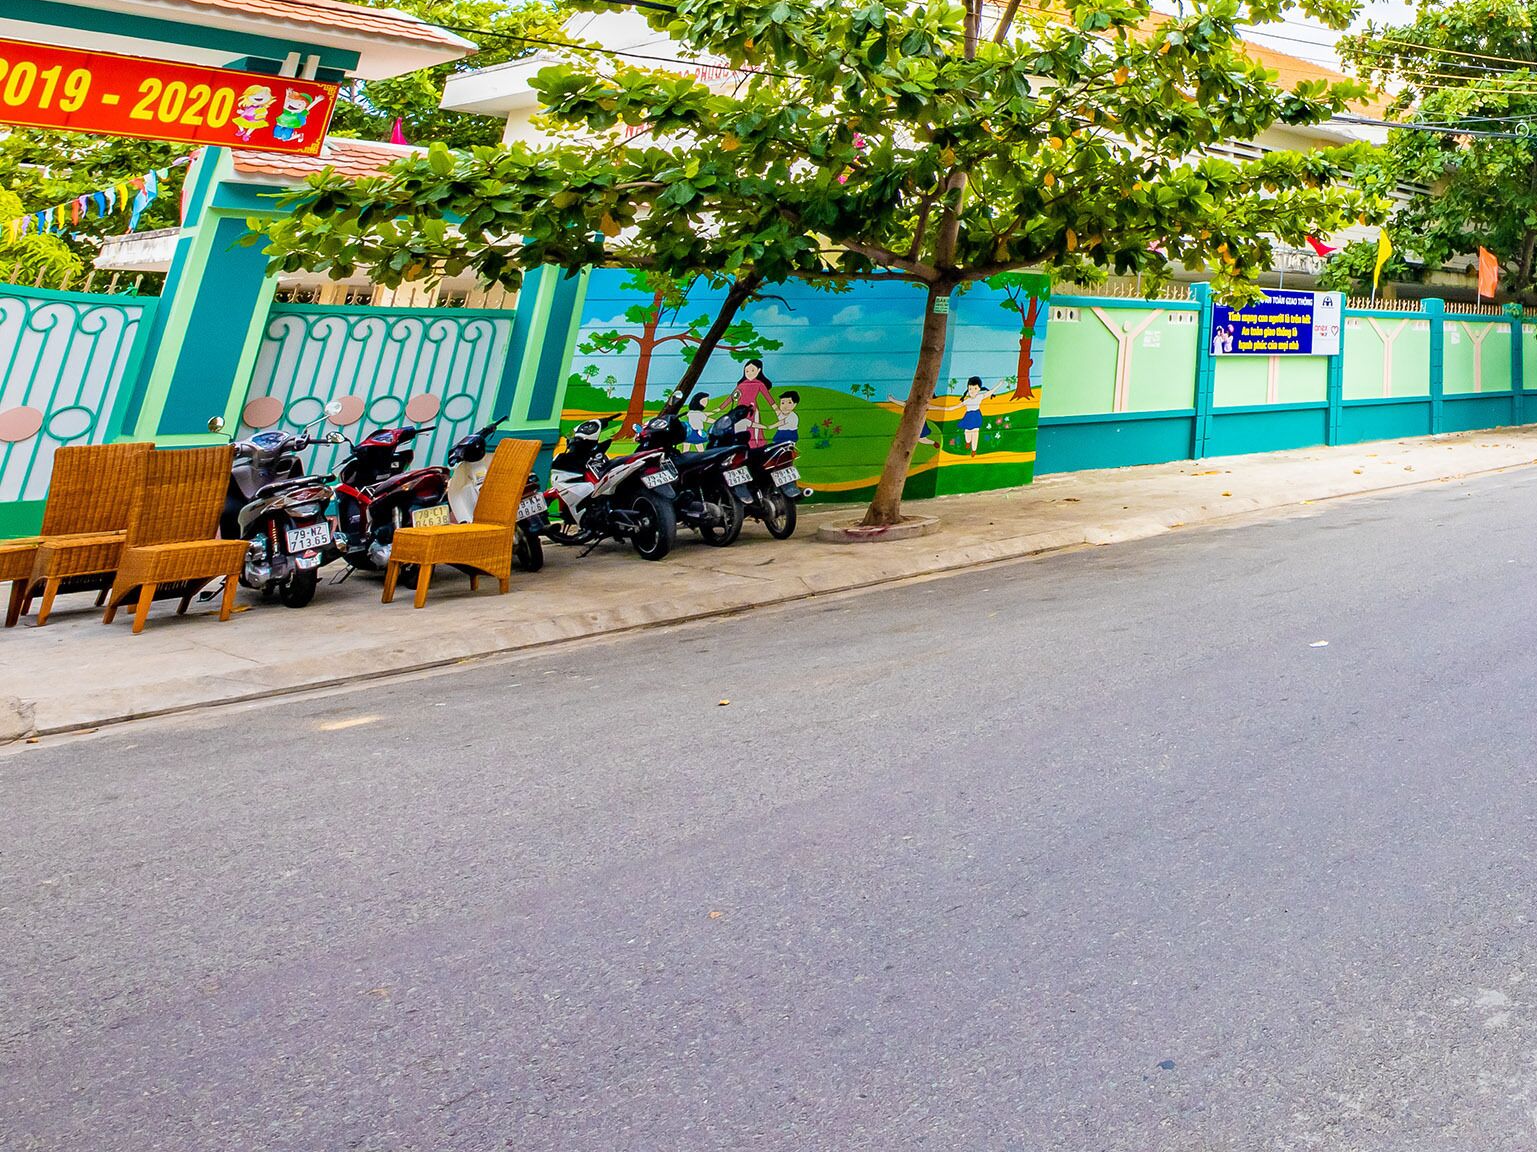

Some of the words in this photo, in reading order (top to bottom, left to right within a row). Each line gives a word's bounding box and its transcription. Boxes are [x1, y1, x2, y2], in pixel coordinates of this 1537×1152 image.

[0, 57, 92, 113] 019
[129, 77, 235, 129] 2020
[291, 534, 328, 551] 713.65
